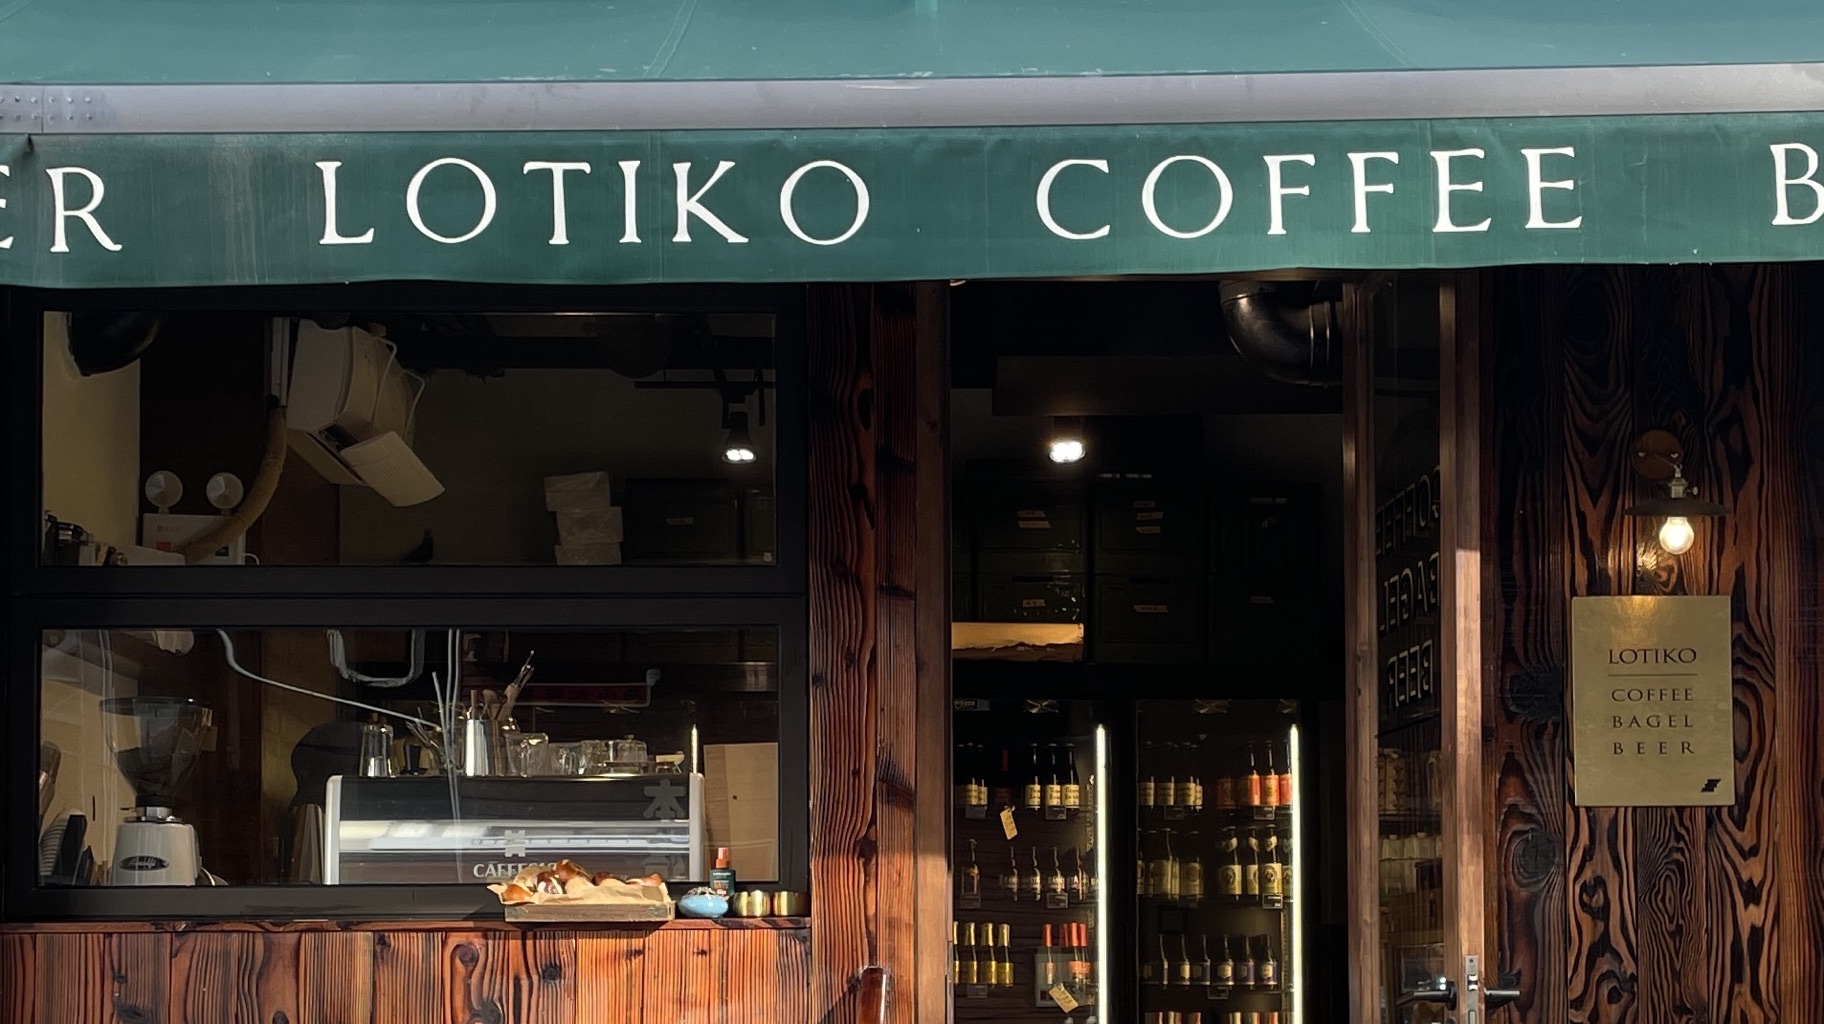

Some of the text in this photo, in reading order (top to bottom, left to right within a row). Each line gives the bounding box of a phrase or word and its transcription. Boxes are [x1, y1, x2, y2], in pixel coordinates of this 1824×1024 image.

[315, 156, 871, 246] LOTIKO
[1035, 146, 1583, 240] COFFEE
[1608, 647, 1697, 665] LOTIKO
[1611, 687, 1694, 702] COFFEE
[1612, 714, 1694, 729] BAGEL
[1613, 741, 1695, 755] BEER
